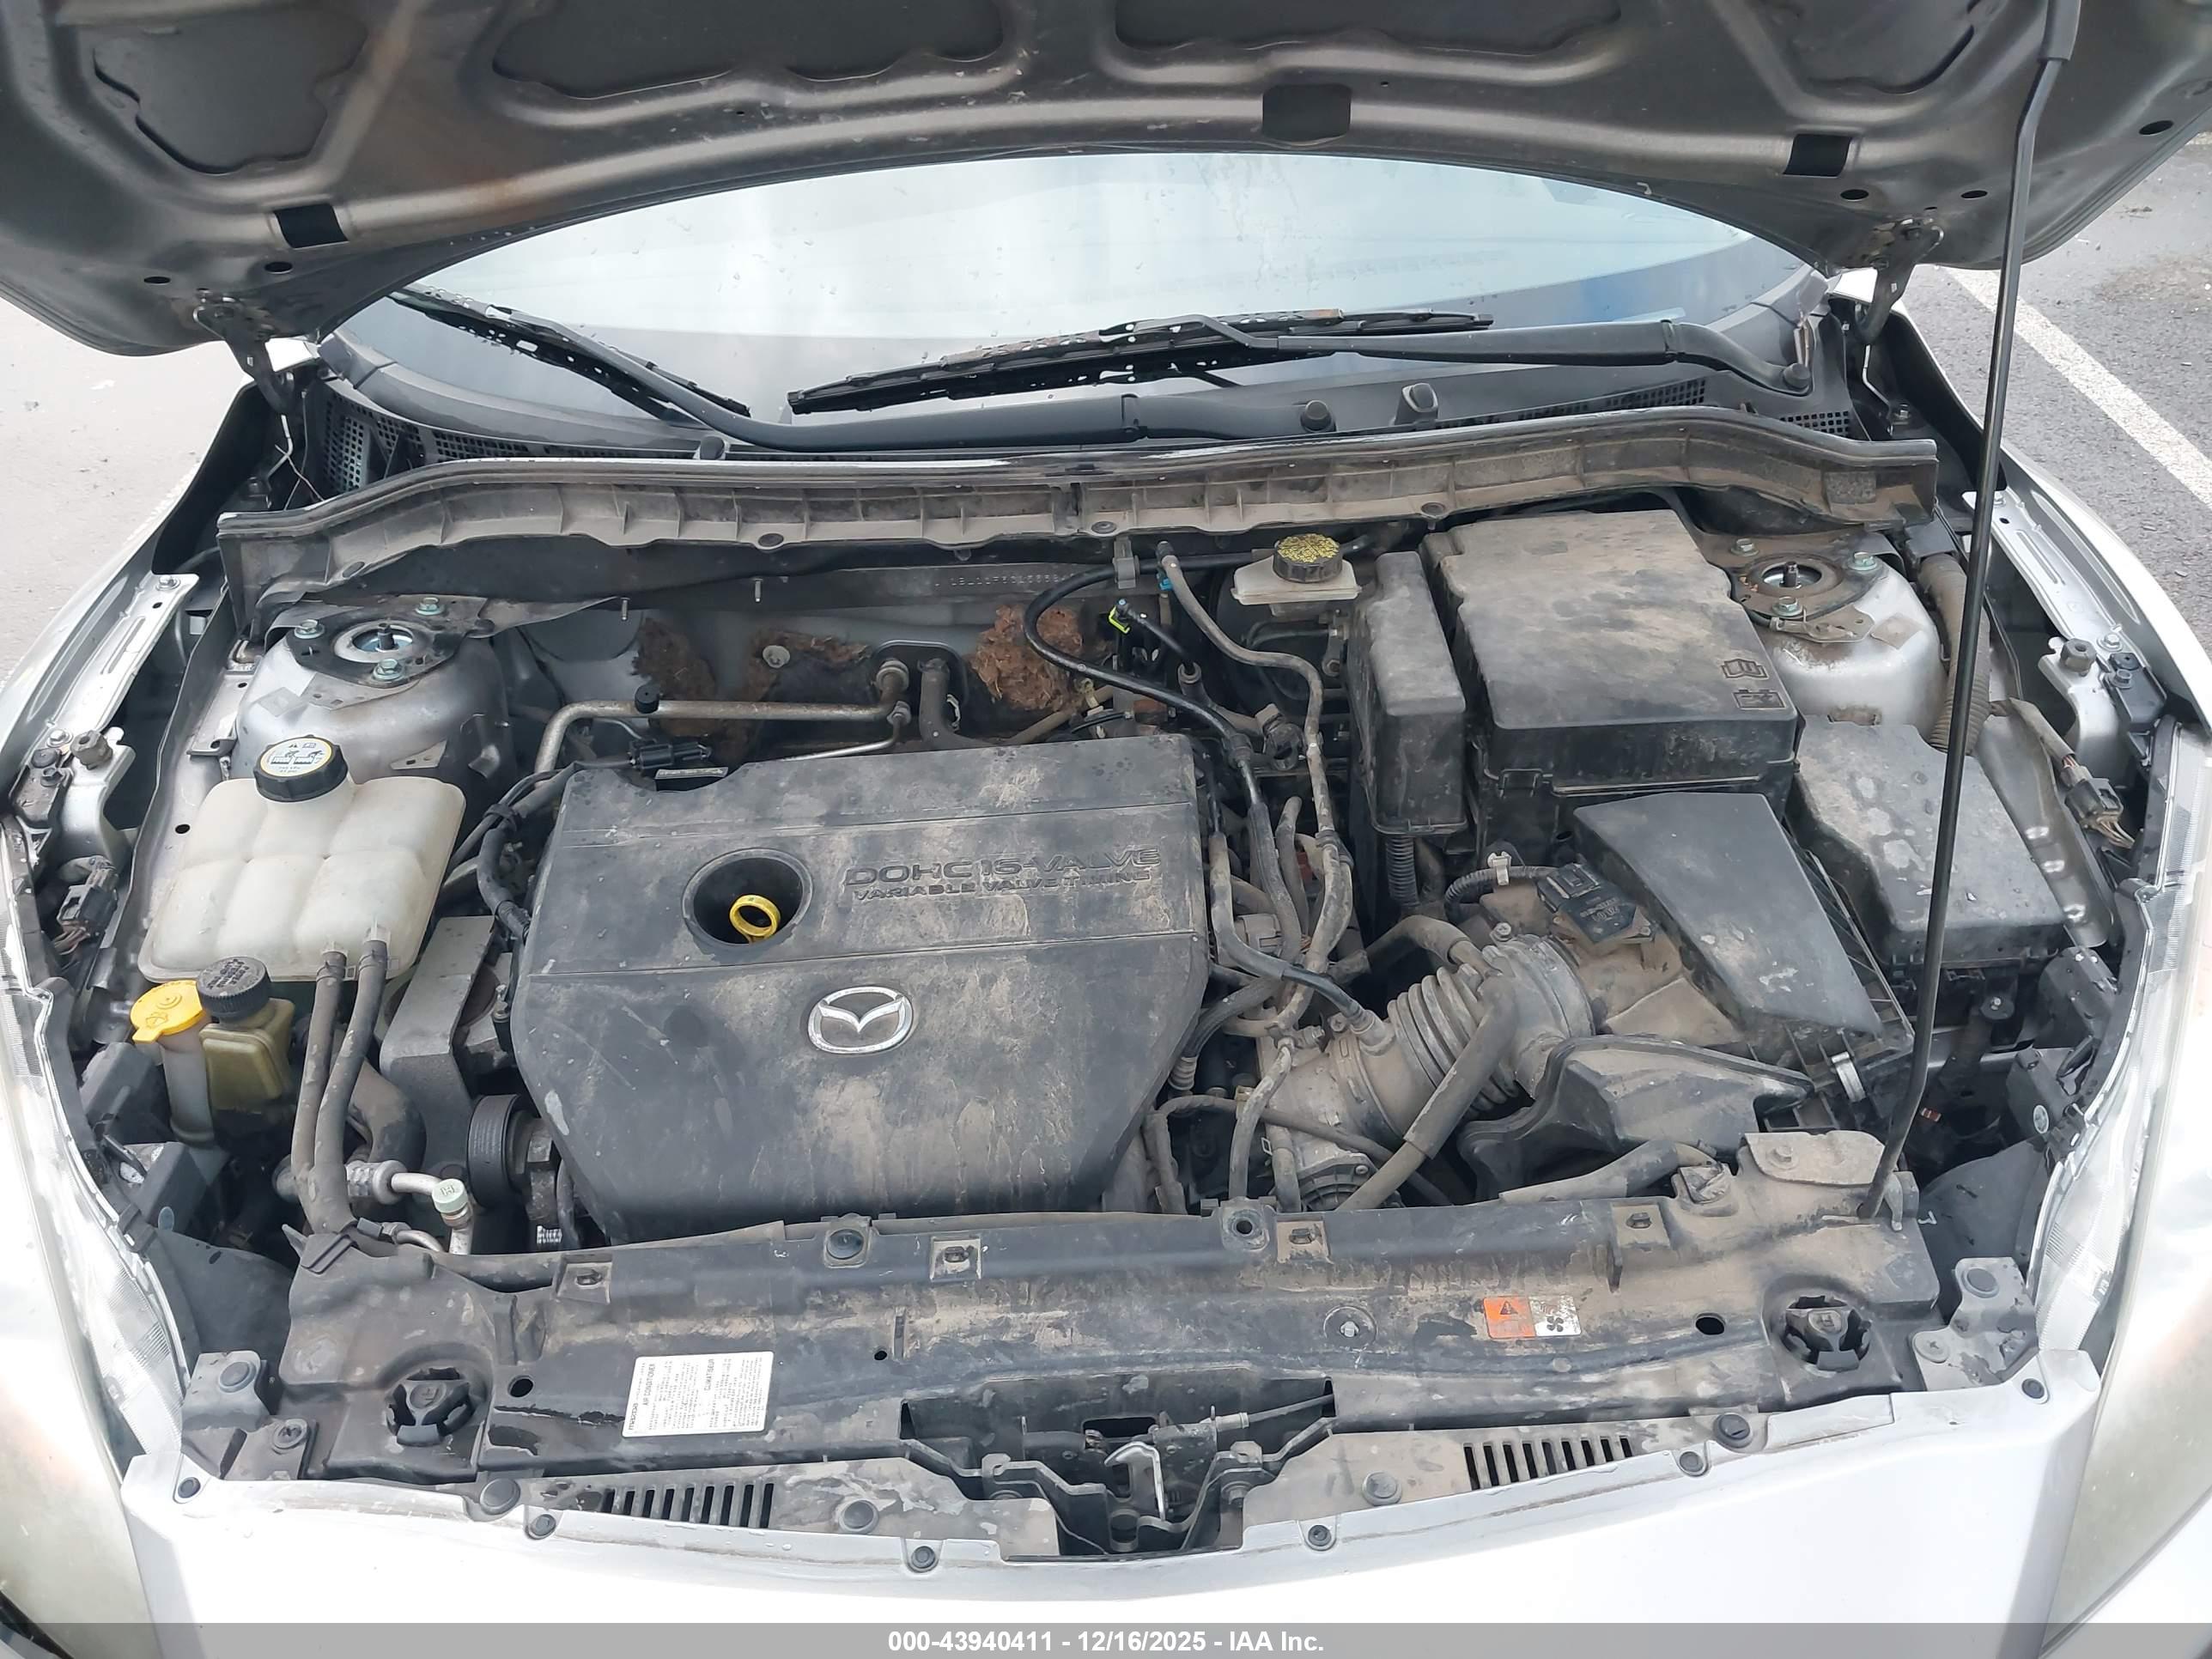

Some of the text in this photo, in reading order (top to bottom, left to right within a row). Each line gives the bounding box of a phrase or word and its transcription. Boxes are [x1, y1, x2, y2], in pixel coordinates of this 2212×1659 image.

[845, 860, 972, 886] DOHC
[854, 882, 975, 901] VARIABLE
[983, 878, 1059, 891] VALVE
